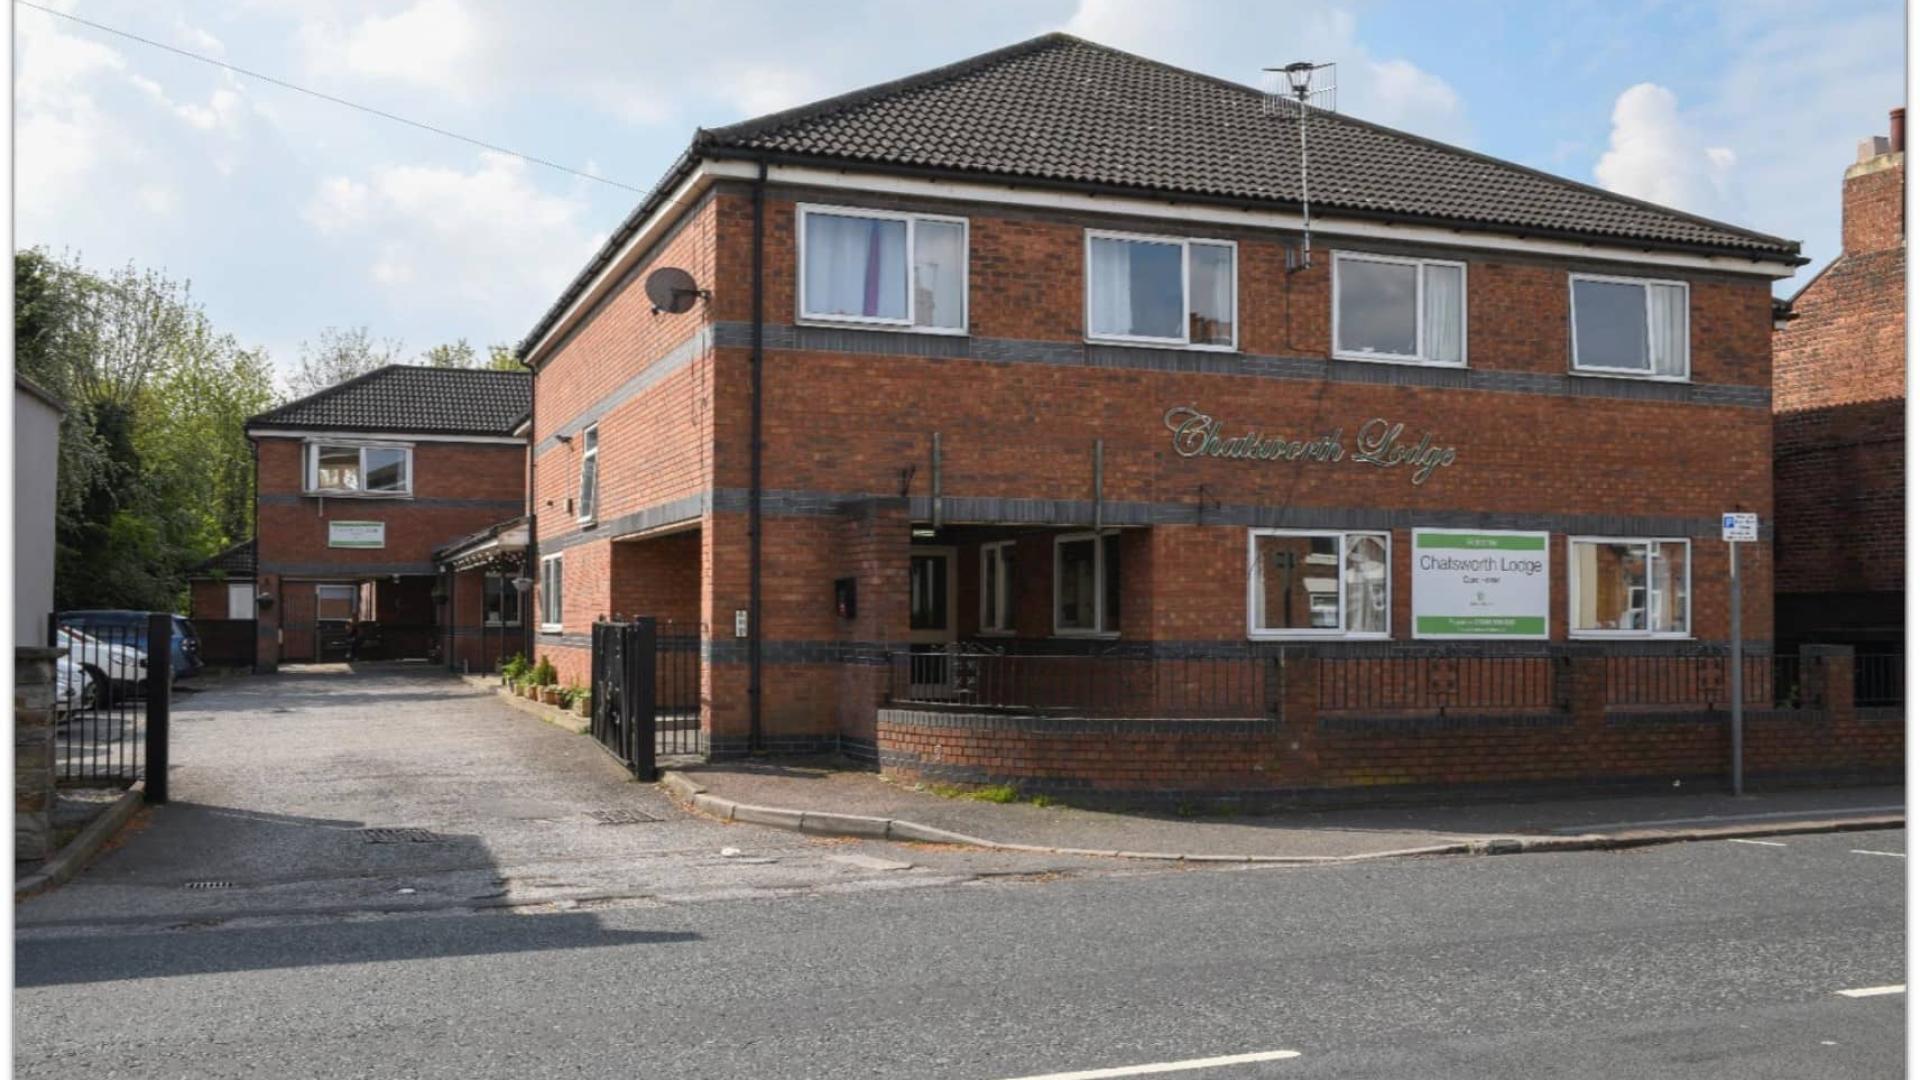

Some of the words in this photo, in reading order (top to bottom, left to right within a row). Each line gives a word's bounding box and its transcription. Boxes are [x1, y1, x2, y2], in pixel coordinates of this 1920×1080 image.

[1164, 406, 1345, 462] Chatsworth
[1352, 417, 1457, 485] Lodge
[1420, 555, 1496, 571] Chatsworth
[1501, 557, 1542, 575] Lodge
